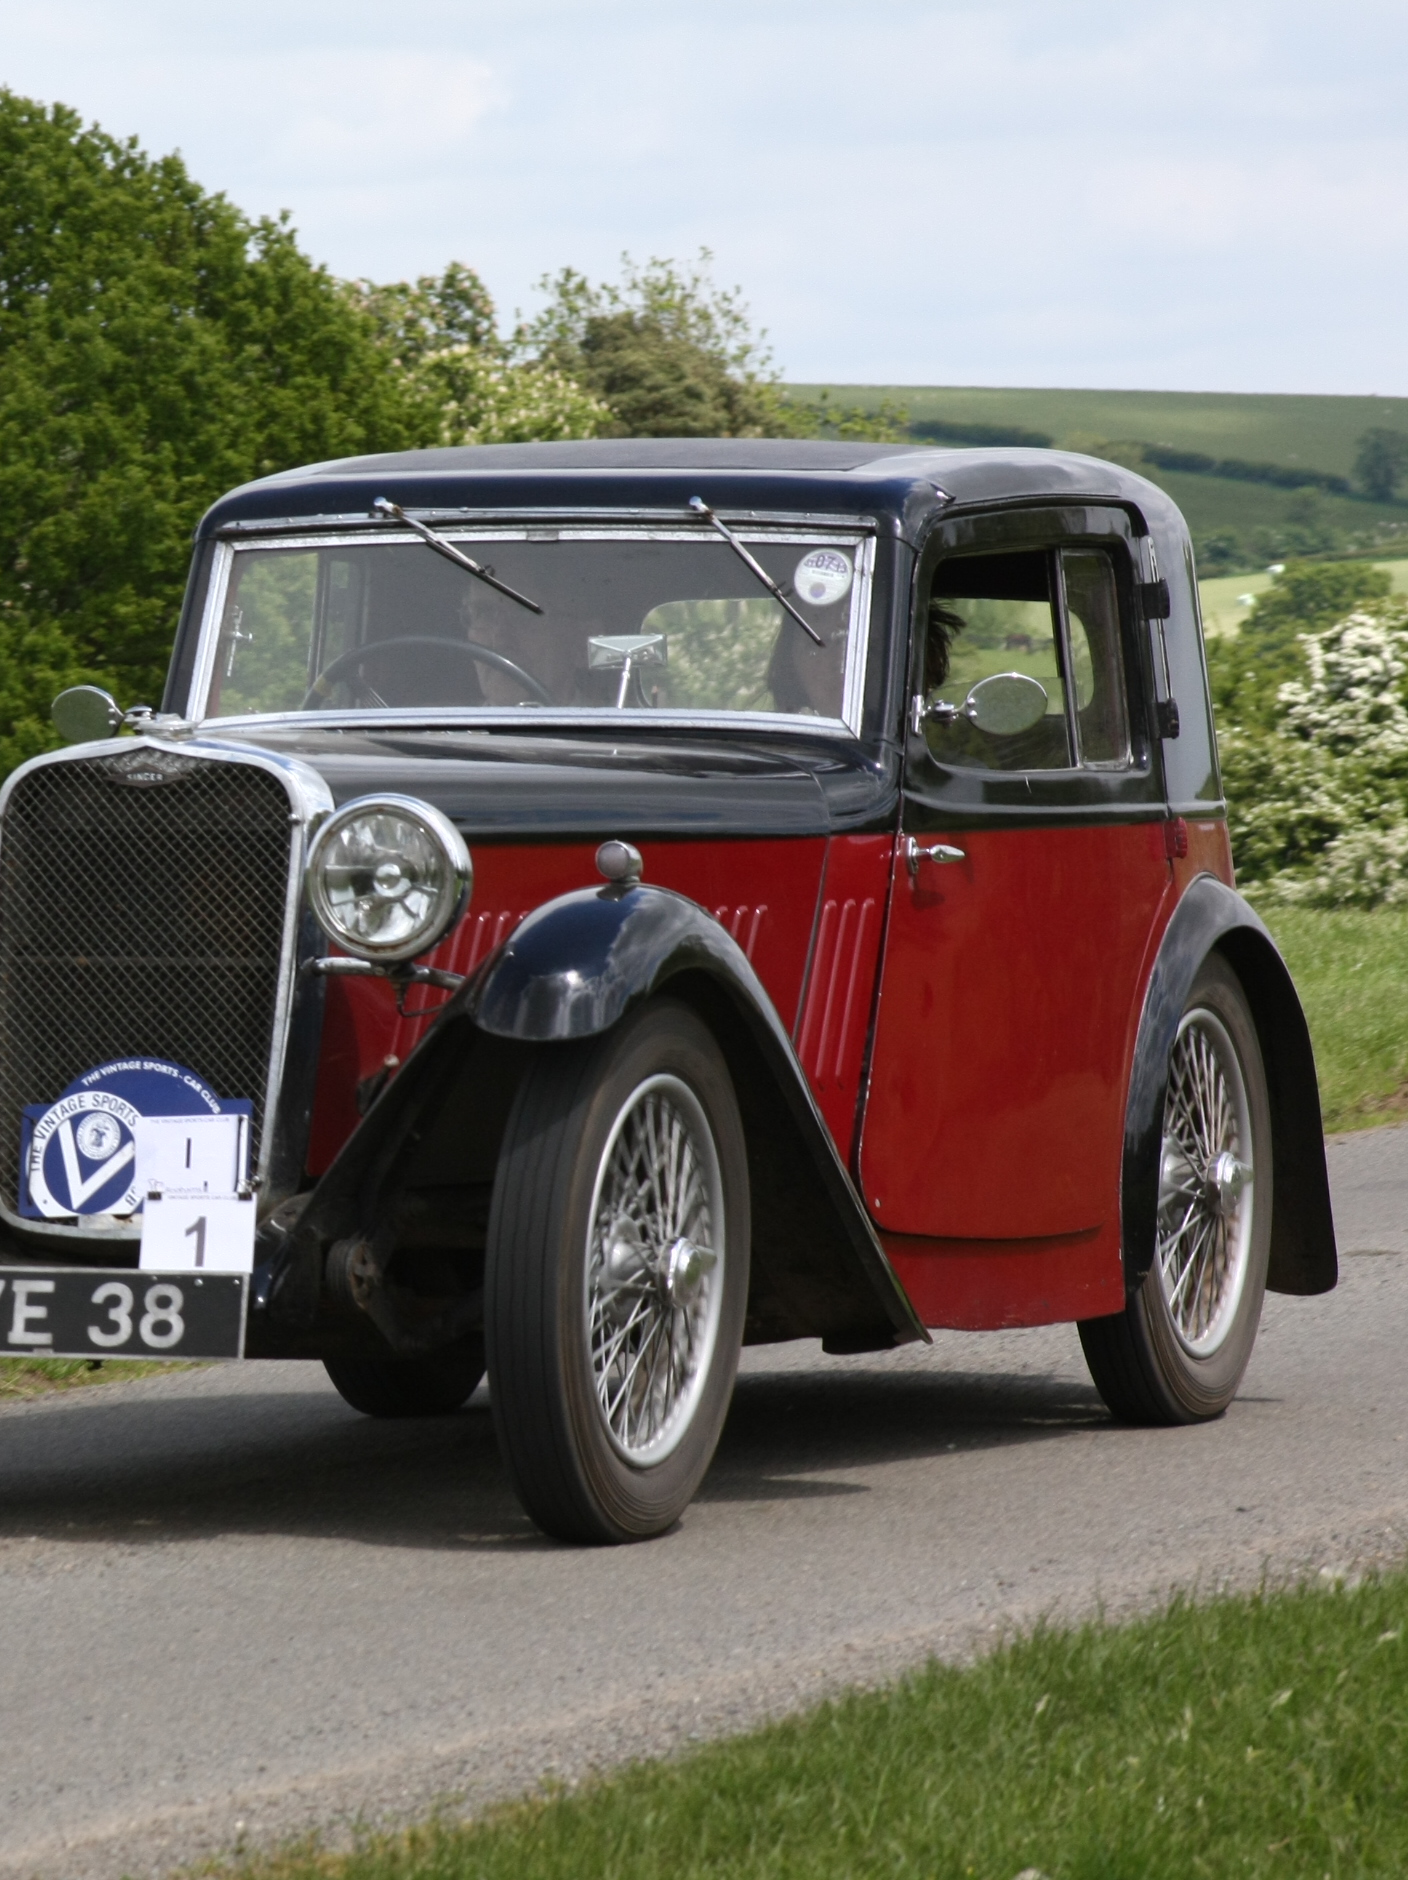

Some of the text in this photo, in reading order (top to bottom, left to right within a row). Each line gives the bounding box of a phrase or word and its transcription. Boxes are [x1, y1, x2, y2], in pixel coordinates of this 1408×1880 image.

[126, 772, 164, 781] SINGER
[81, 1070, 101, 1087] THE
[100, 1060, 142, 1076] VINTAGE
[200, 1090, 221, 1114] CLUB
[34, 1095, 86, 1140] VINTAGE
[92, 1093, 139, 1127] SPORTS
[31, 1146, 43, 1171] THE
[184, 1216, 207, 1267] 1
[87, 1282, 185, 1348] 38
